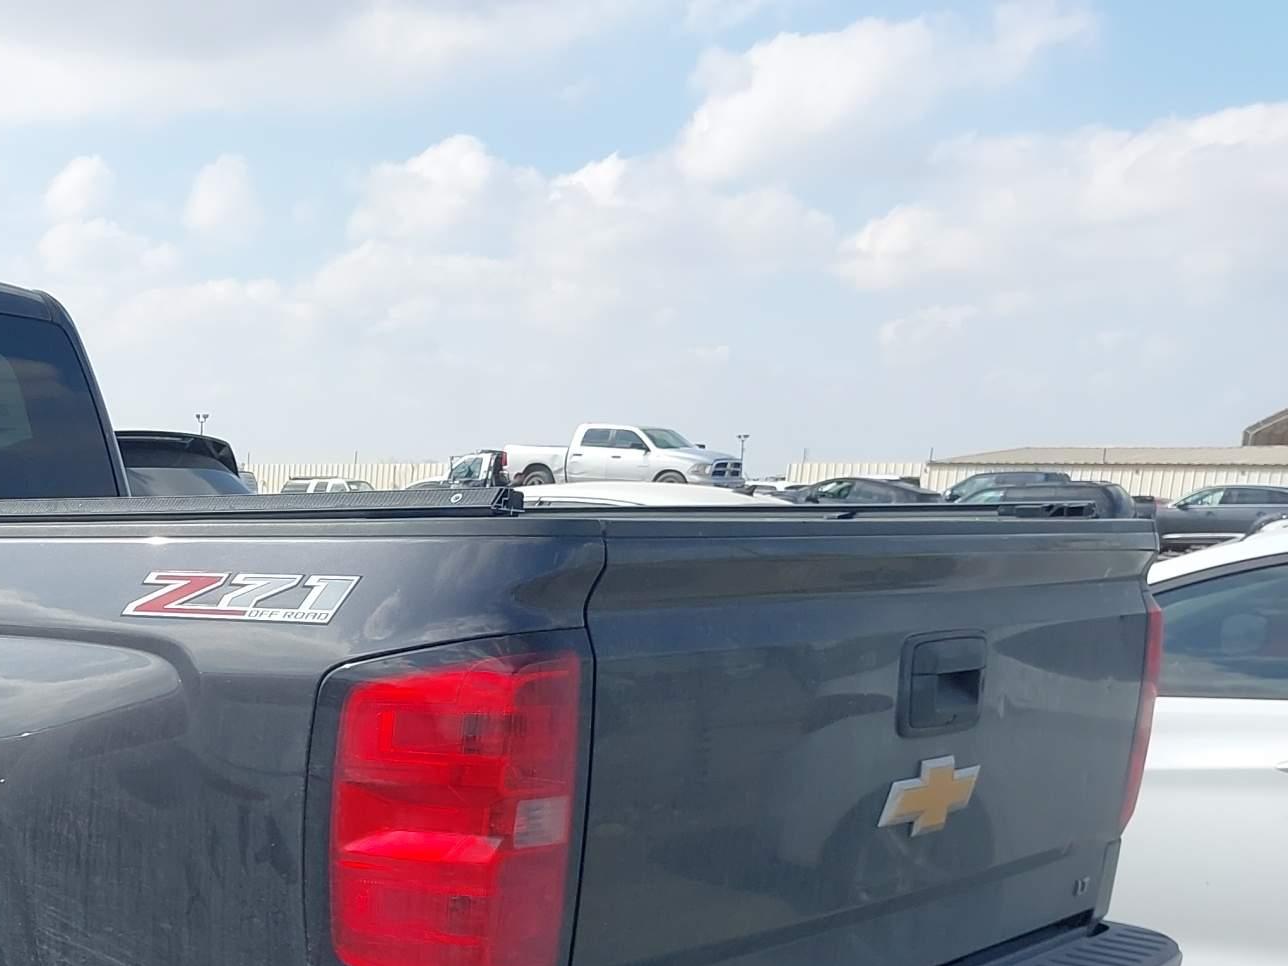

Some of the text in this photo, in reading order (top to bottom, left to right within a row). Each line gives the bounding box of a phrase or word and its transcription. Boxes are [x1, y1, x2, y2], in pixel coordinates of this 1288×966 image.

[121, 570, 363, 625] Z71
[247, 608, 330, 622] OFF ROAD
